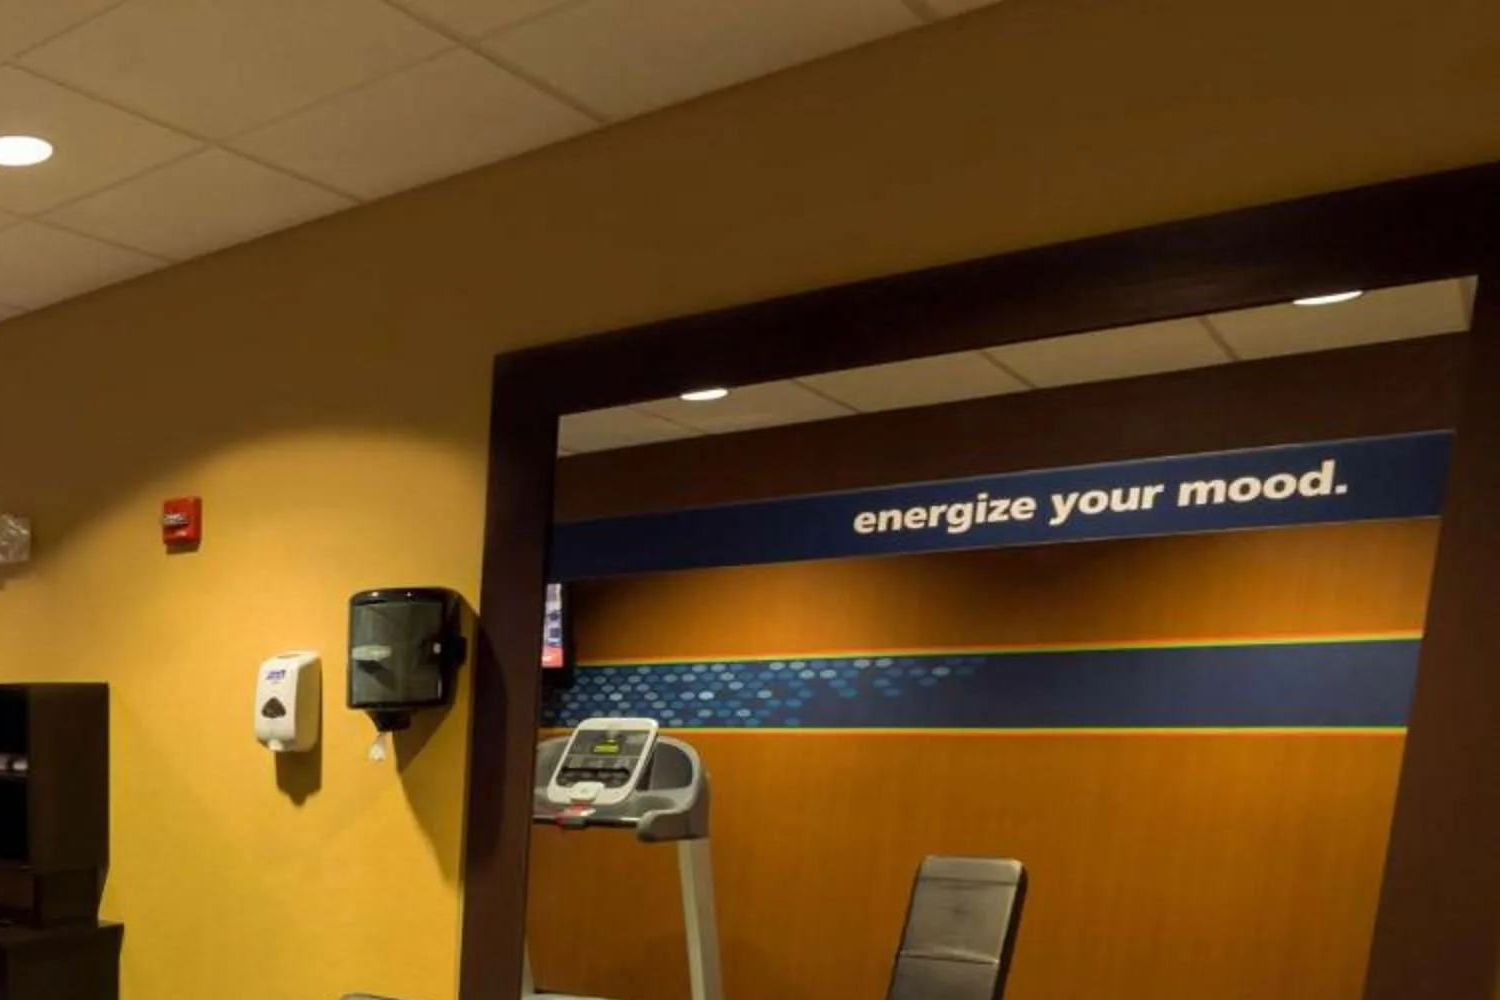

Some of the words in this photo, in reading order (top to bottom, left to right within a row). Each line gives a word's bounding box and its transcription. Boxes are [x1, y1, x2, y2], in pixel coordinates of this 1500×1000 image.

[853, 492, 1037, 534] energize
[1048, 484, 1165, 526] your
[1177, 459, 1348, 507] mood.
